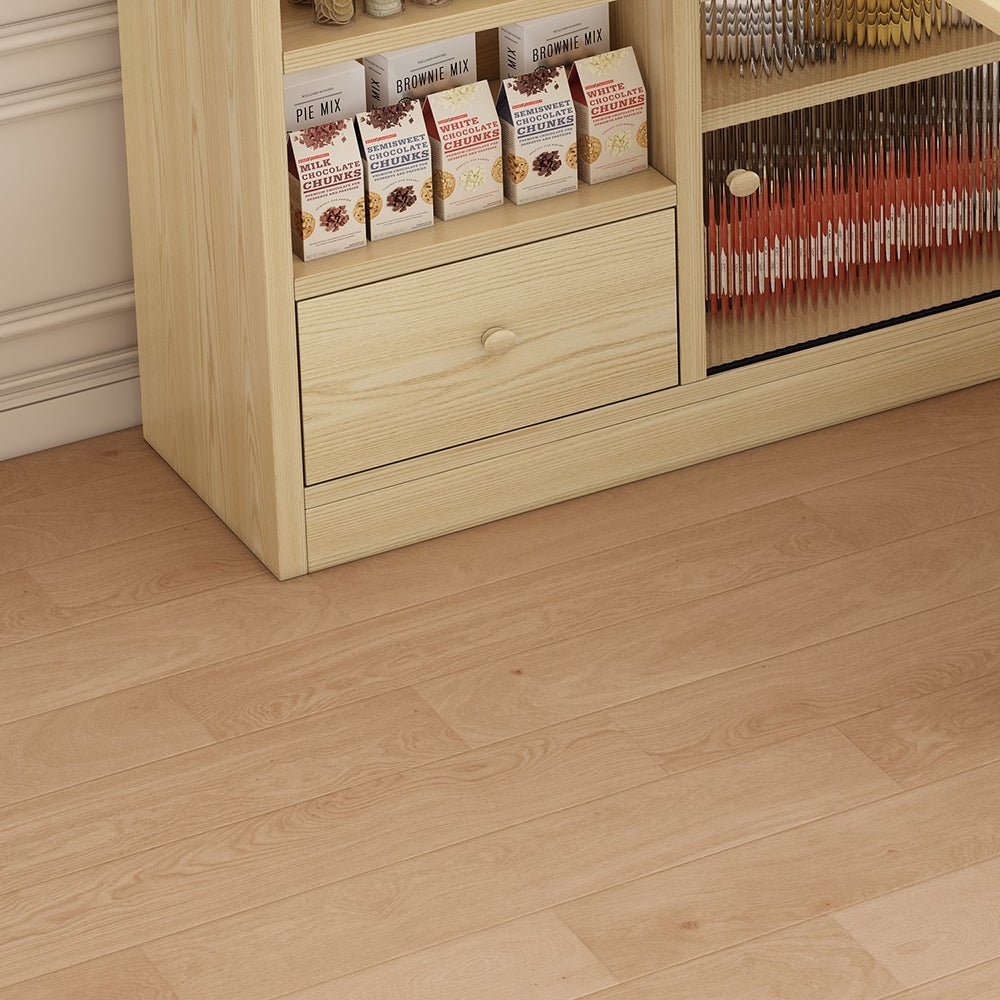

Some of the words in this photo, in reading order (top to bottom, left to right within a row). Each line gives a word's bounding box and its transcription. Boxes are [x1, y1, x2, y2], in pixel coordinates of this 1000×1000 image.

[532, 35, 579, 62] BROWNIE
[584, 28, 603, 46] MIX
[507, 46, 517, 70] MIX
[396, 66, 445, 94] BROWNIE
[450, 58, 469, 77] MIX
[371, 77, 380, 101] MIX
[587, 82, 625, 98] WHITE
[590, 86, 644, 106] CHOCOLATE
[296, 105, 314, 123] PIE
[320, 98, 341, 116] MIX
[513, 99, 571, 118] SEMISWEET
[591, 94, 645, 115] CHUNKS
[440, 116, 479, 133] WHITE
[516, 107, 573, 126] CHOCOLATE
[517, 115, 574, 135] CHUNKS
[442, 121, 499, 141] CHOCOLATE
[444, 129, 500, 150] CHUNKS
[367, 134, 426, 153] SEMISWEET
[369, 141, 429, 161] CHOCOLATE
[300, 159, 331, 173] MILK
[370, 149, 429, 170] CHUNKS
[302, 161, 360, 180] CHOCOLATE
[303, 169, 361, 190] CHUNKS
